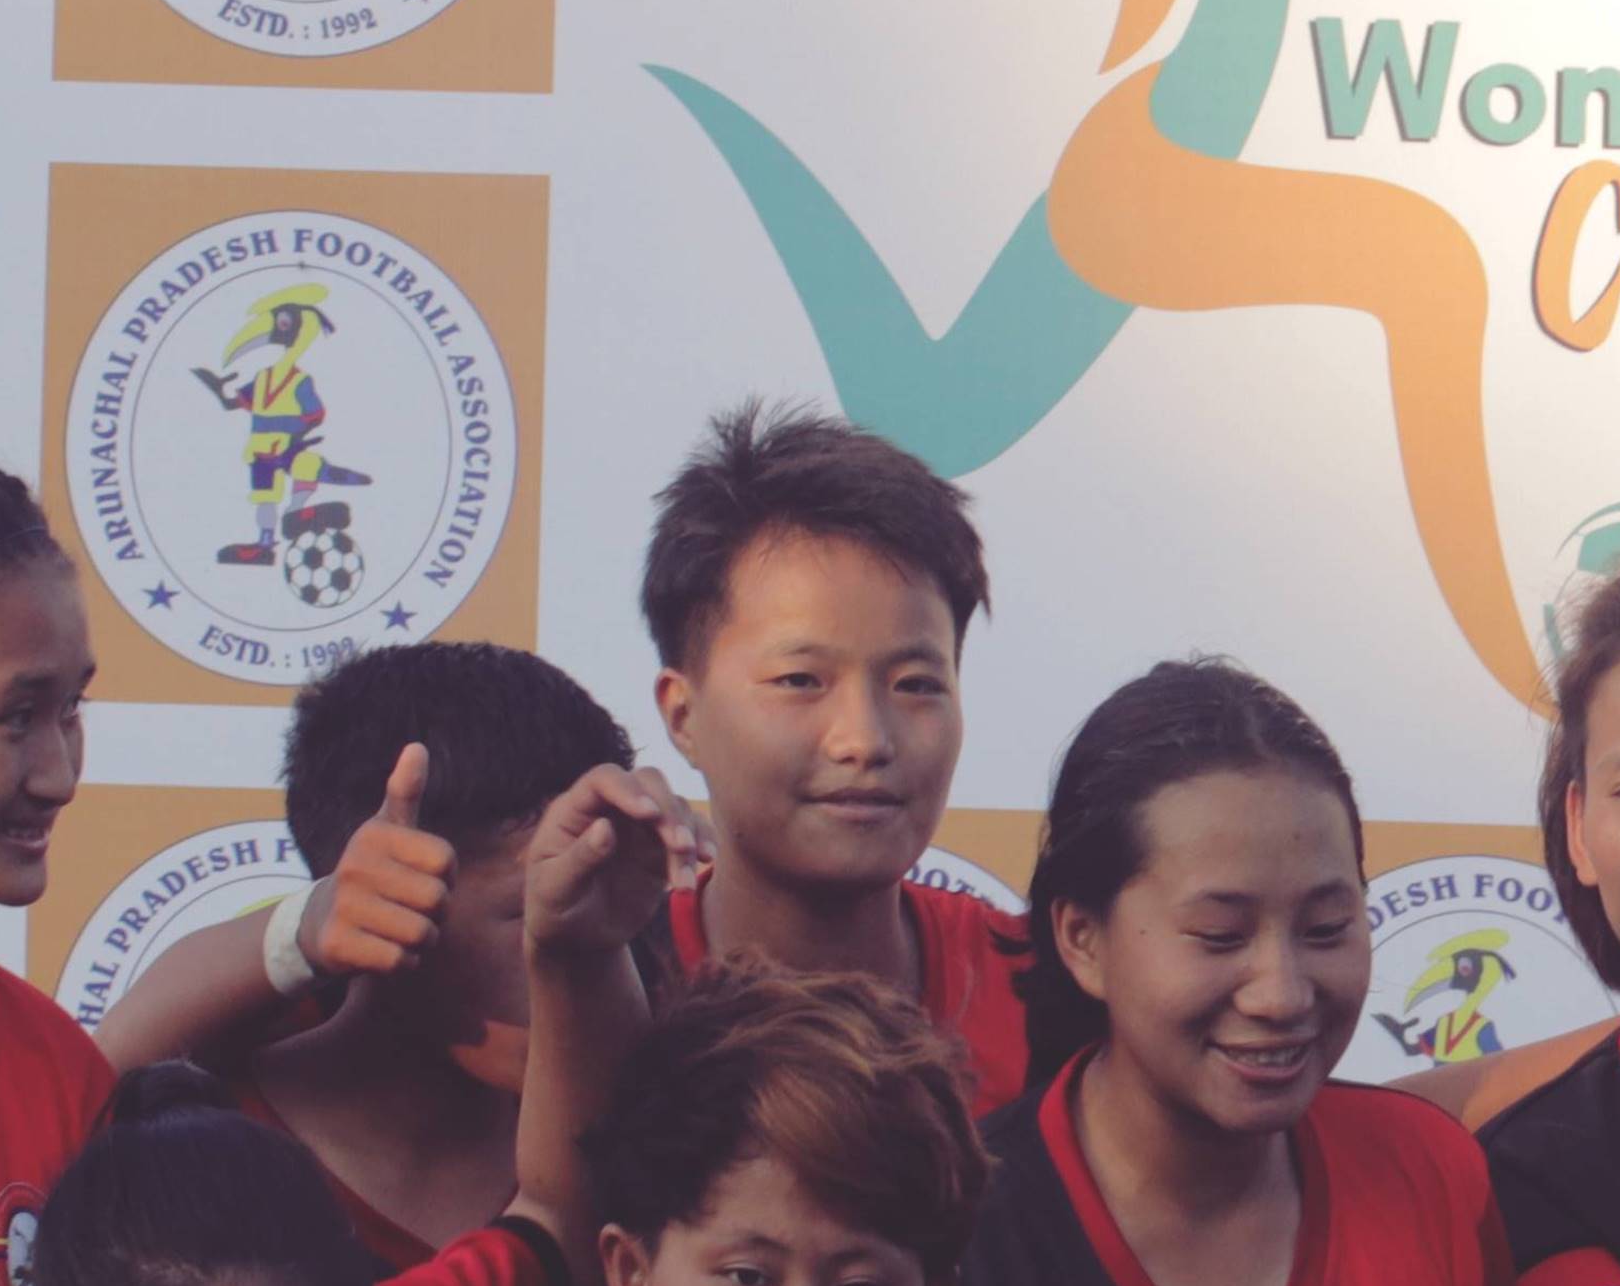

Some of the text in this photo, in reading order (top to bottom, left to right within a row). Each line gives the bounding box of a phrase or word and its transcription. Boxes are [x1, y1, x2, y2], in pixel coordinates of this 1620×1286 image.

[319, 7, 378, 40] 1992
[89, 229, 492, 588] ARUNACHAL PRADESH FOOTBALL ASSOCIATION
[104, 839, 261, 954] PRADESH
